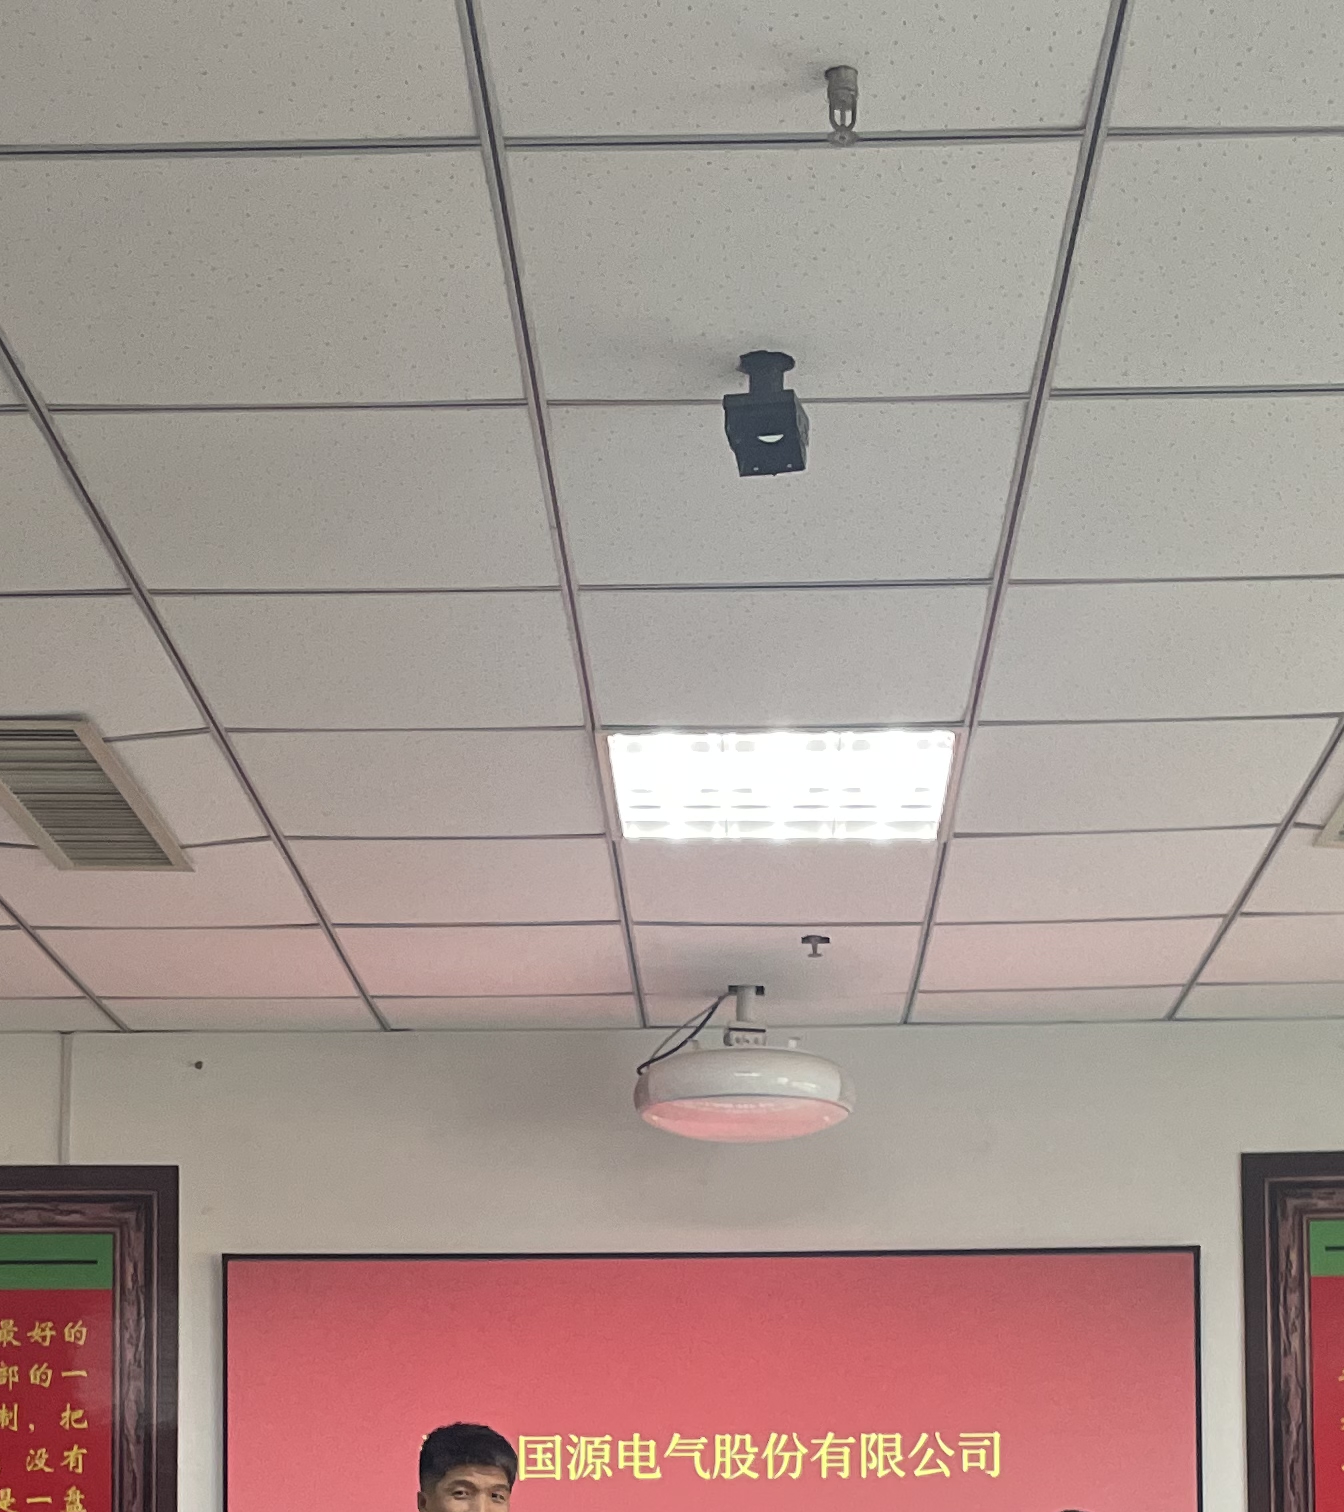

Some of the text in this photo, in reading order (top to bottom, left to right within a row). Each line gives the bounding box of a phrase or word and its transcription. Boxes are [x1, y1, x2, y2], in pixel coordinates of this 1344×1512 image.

[419, 1431, 1003, 1481] 国源电气股份有限公司
